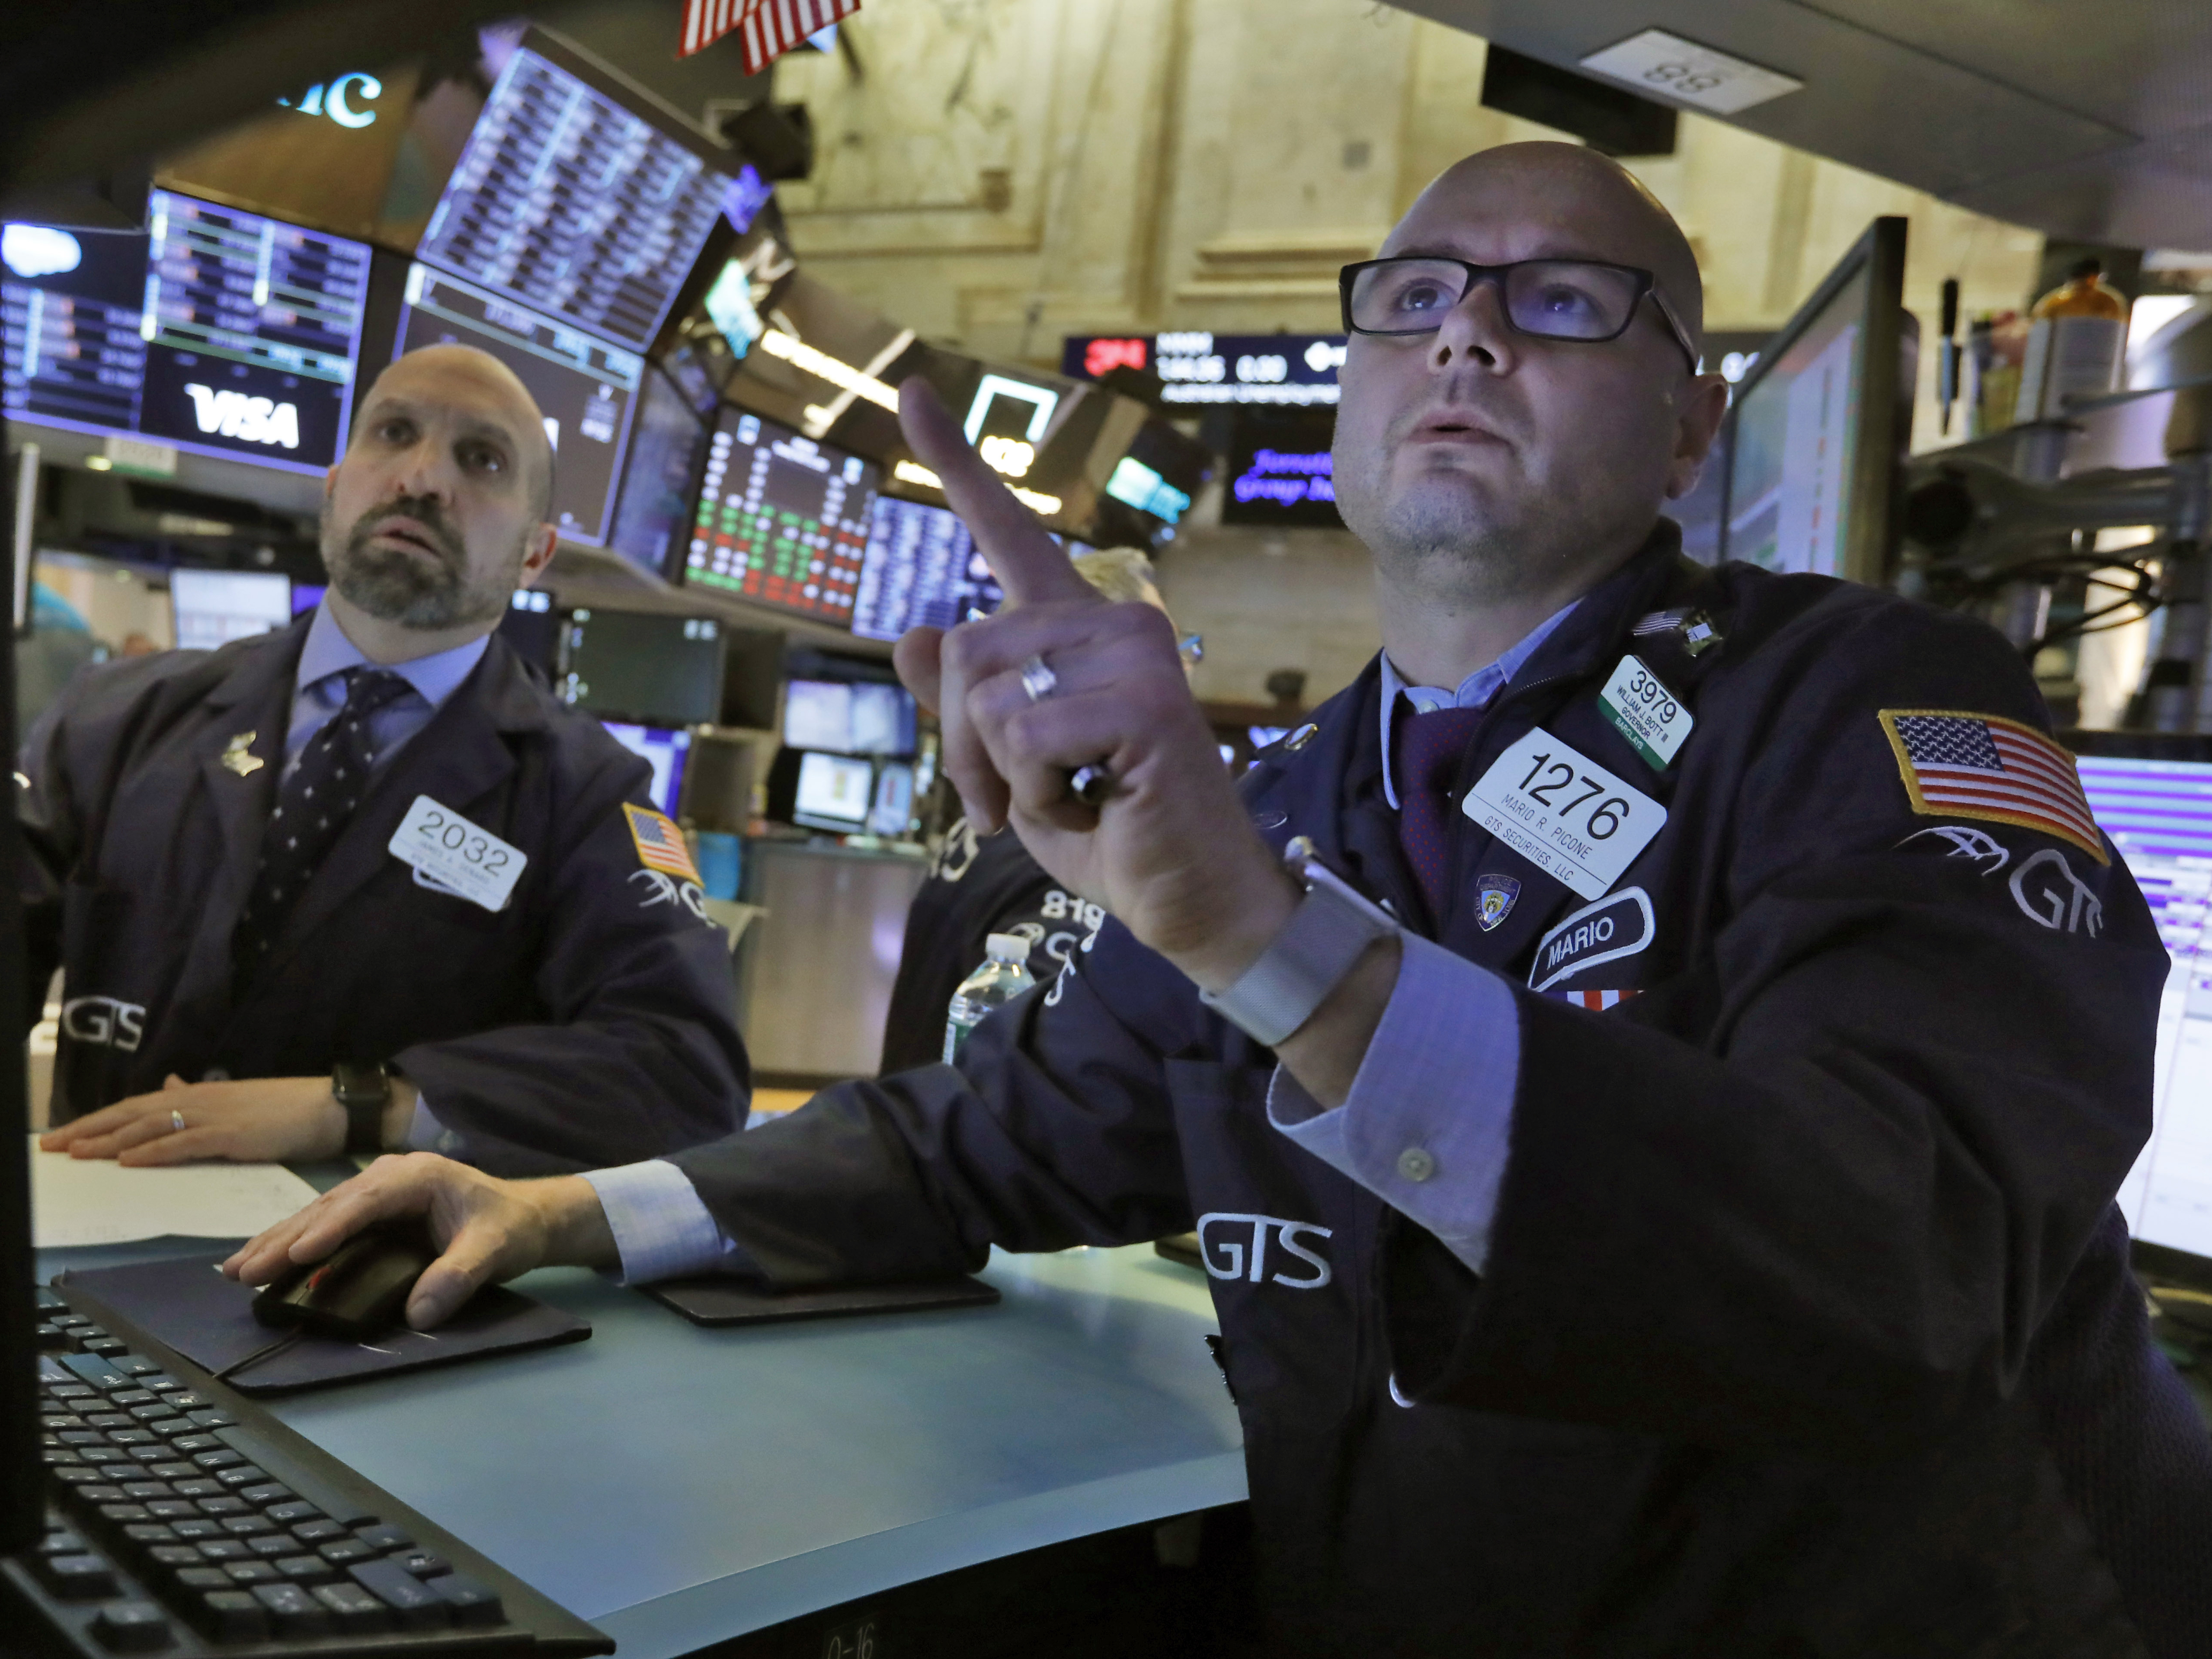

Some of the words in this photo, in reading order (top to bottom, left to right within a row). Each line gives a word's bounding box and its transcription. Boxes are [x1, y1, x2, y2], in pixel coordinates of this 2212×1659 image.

[184, 383, 299, 448] VISA
[1617, 685, 1642, 714] WILLIAM
[1645, 716, 1664, 736] BOTT
[1622, 706, 1651, 739] GOVERNOR
[1630, 670, 1677, 724] 3979
[1615, 717, 1643, 750] BARCLAYS
[1501, 794, 1535, 821] MARIO
[1536, 818, 1547, 832] R.
[1551, 826, 1593, 860] PICONE
[1519, 753, 1629, 840] 1276
[418, 810, 509, 877] 2032
[1484, 816, 1503, 832] GTS
[1554, 863, 1574, 881] LLC
[1546, 916, 1614, 970] MARIO
[1197, 1212, 1333, 1289] GTS
